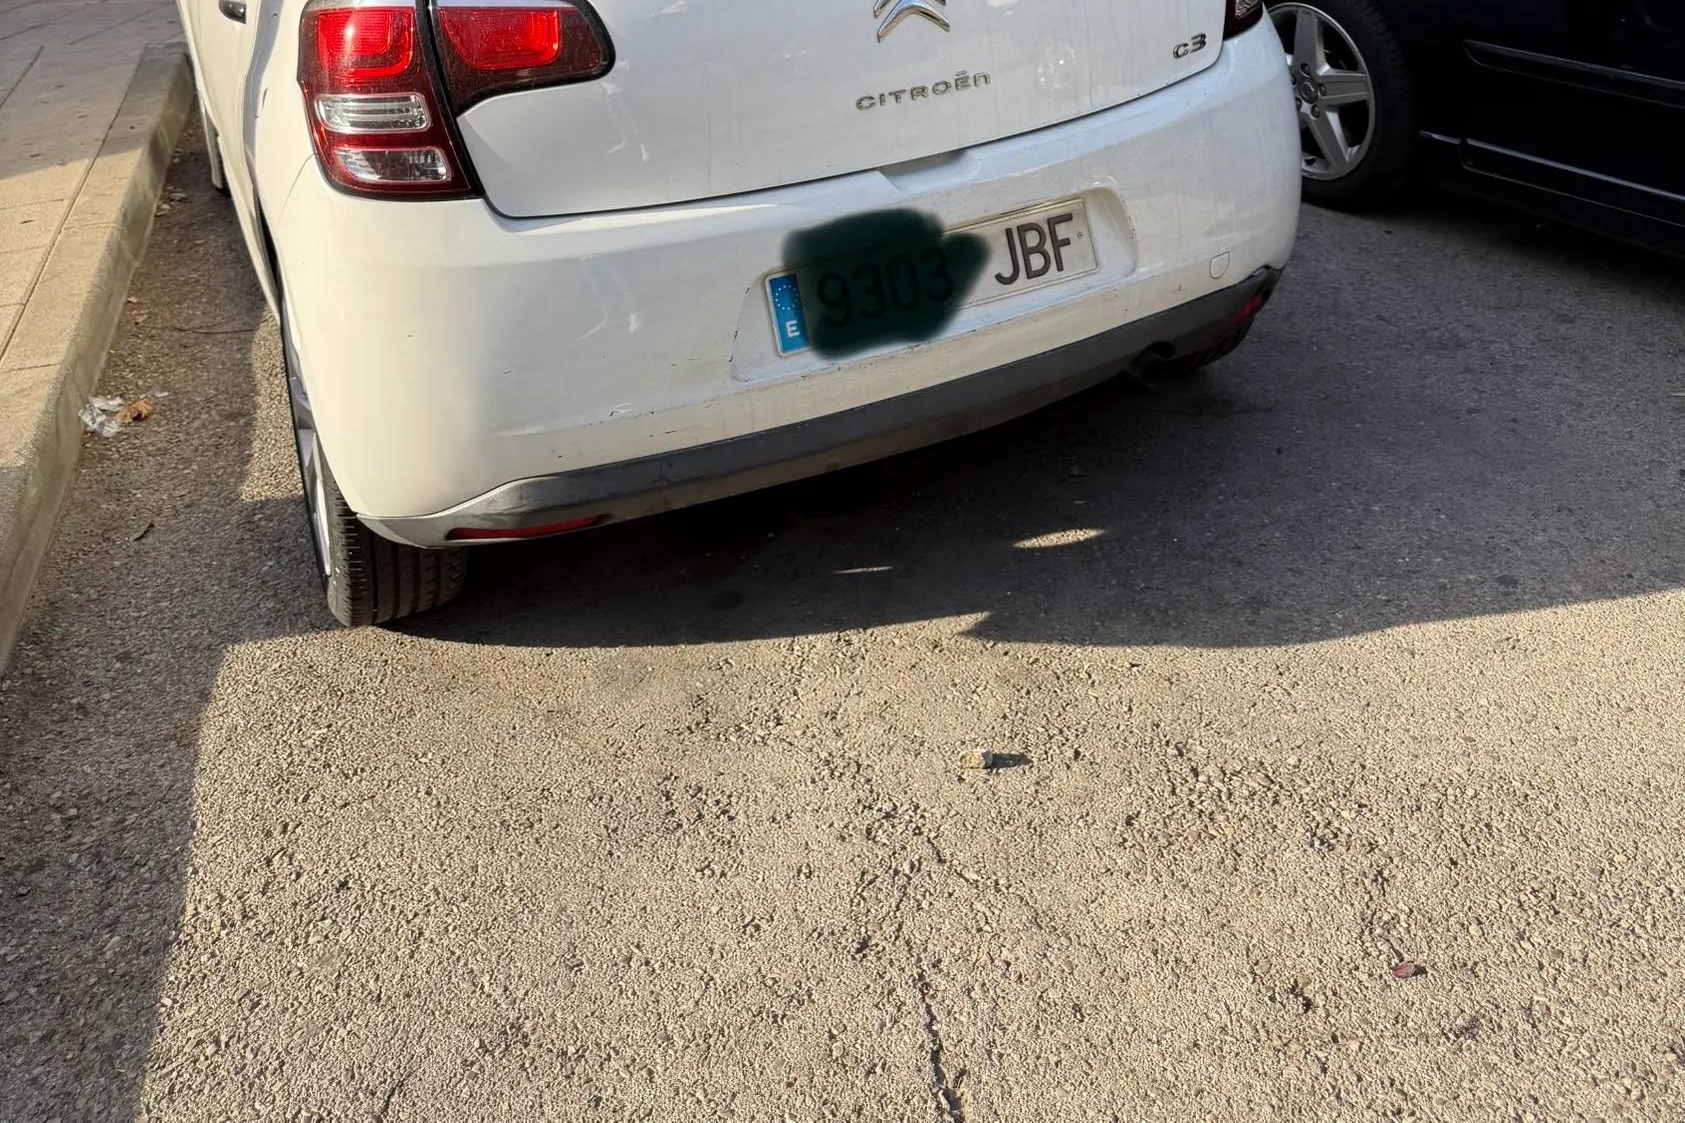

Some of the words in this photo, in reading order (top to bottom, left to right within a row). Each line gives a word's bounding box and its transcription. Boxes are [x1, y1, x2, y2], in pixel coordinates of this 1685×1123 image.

[1172, 33, 1207, 59] C3
[785, 319, 800, 338] E
[995, 212, 1073, 286] JBF
